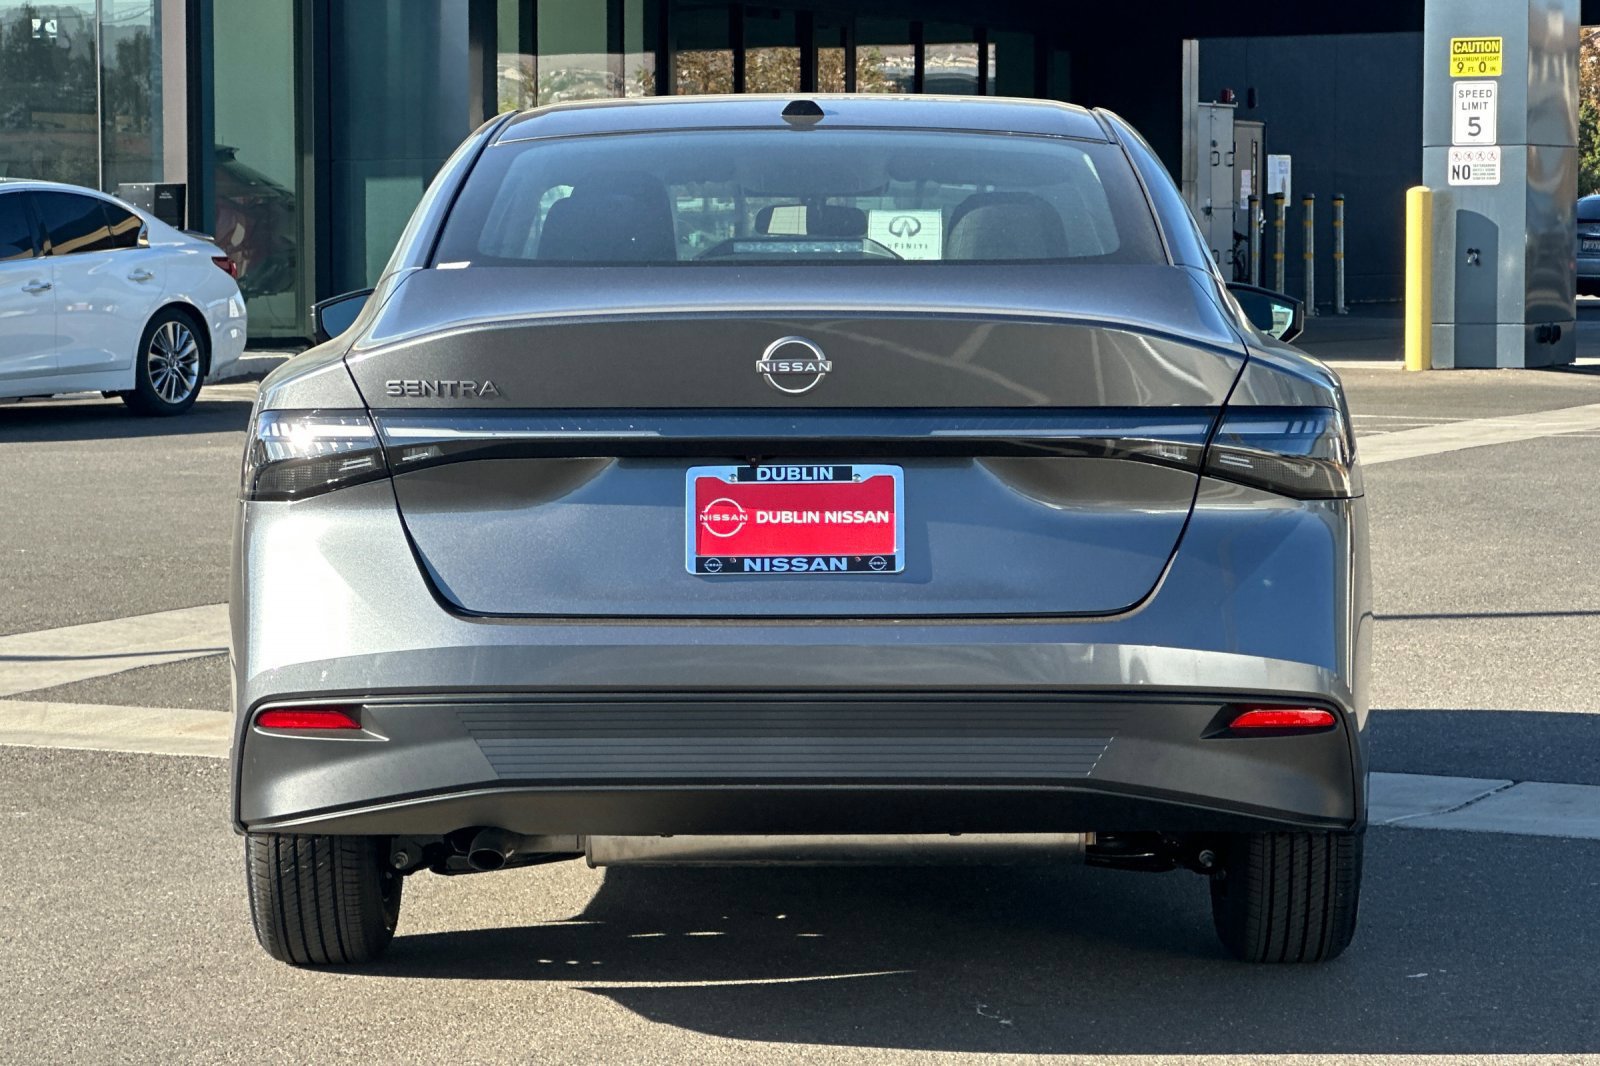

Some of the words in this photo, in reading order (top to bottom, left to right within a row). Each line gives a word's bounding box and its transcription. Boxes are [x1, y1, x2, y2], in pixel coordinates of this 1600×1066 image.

[1454, 41, 1499, 53] CAUTION
[1457, 62, 1464, 73] 9
[1479, 61, 1486, 73] 0
[1458, 89, 1493, 99] SPEED
[1462, 101, 1489, 110] LIMIT
[1467, 116, 1482, 137] 5
[1452, 164, 1471, 180] NO
[759, 362, 830, 372] NISSAN
[385, 380, 500, 396] SENTRA
[756, 466, 833, 481] DUBLIN
[700, 513, 748, 522] NISSAN
[756, 510, 820, 524] DUBLIN
[825, 510, 889, 524] NISSAN
[743, 557, 848, 572] NISSAN
